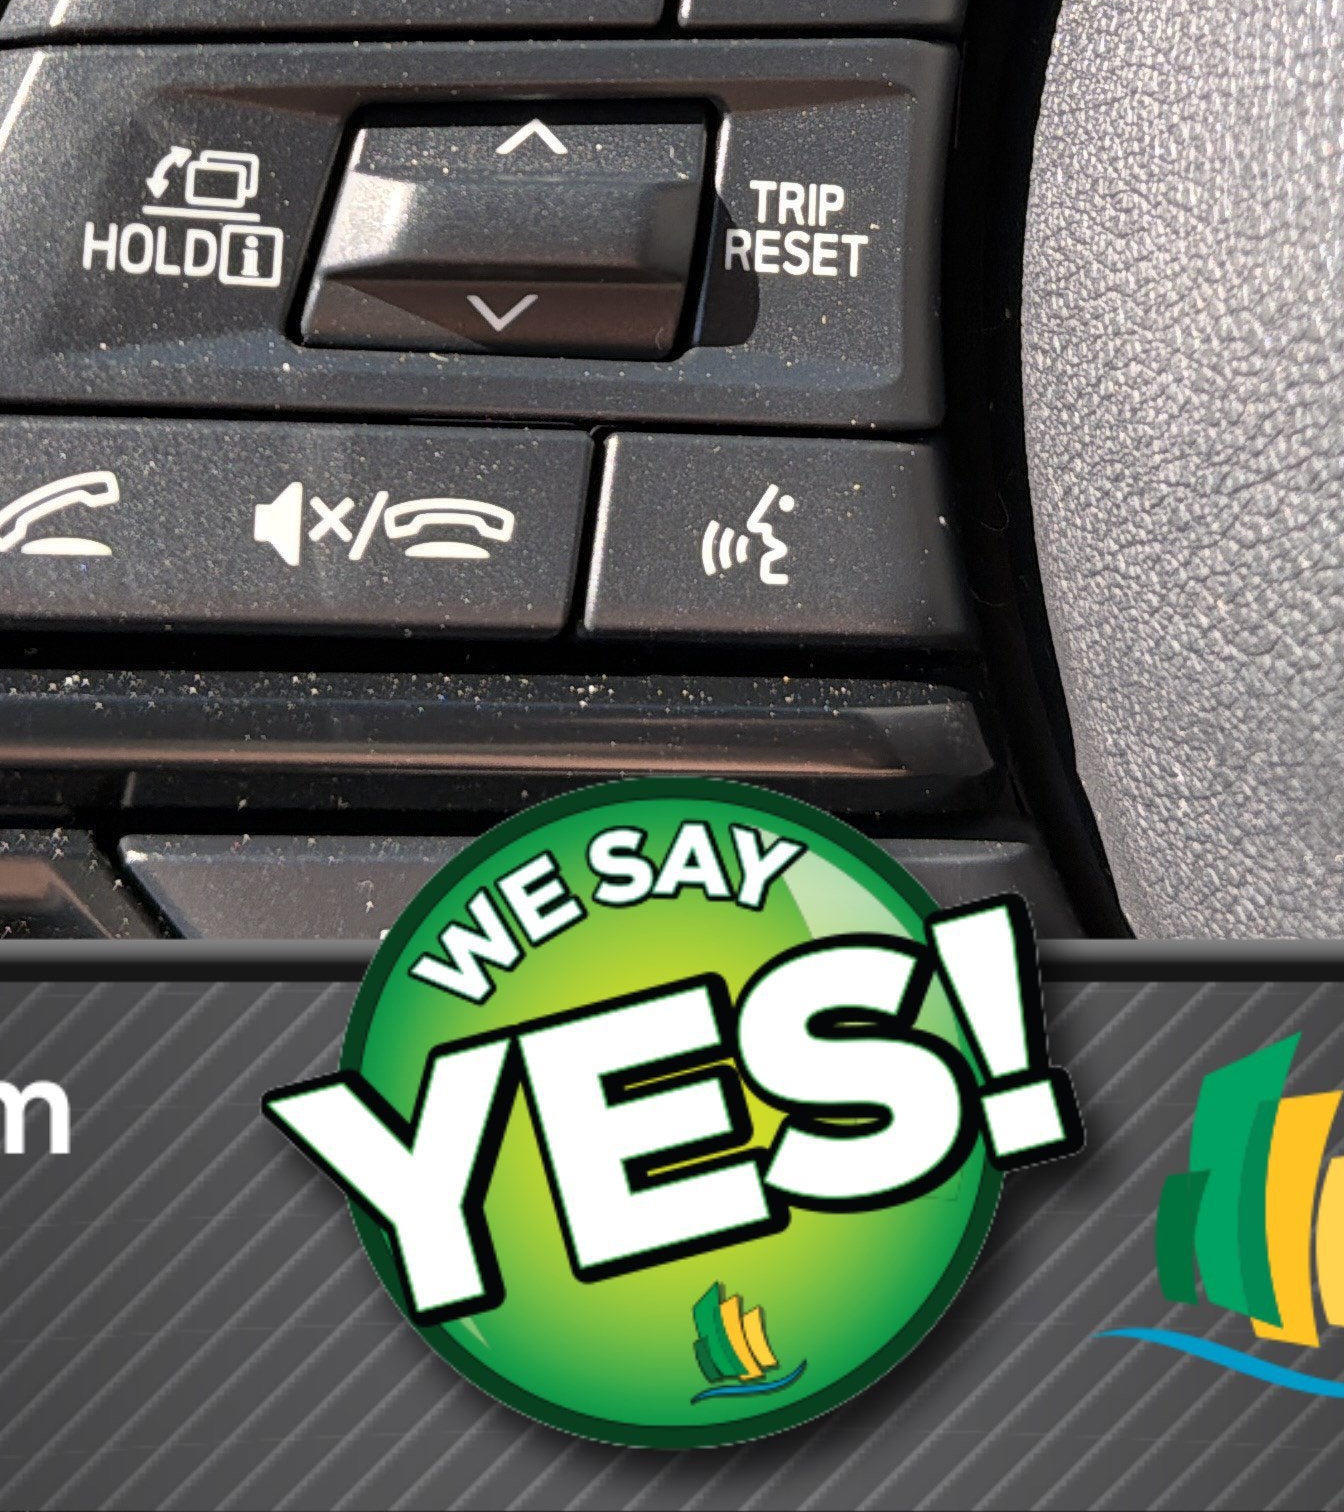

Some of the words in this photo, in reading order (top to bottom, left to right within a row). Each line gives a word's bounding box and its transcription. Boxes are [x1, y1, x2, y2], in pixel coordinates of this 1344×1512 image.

[749, 179, 845, 227] TRIP
[82, 221, 219, 277] HOLD
[724, 228, 869, 278] RESET
